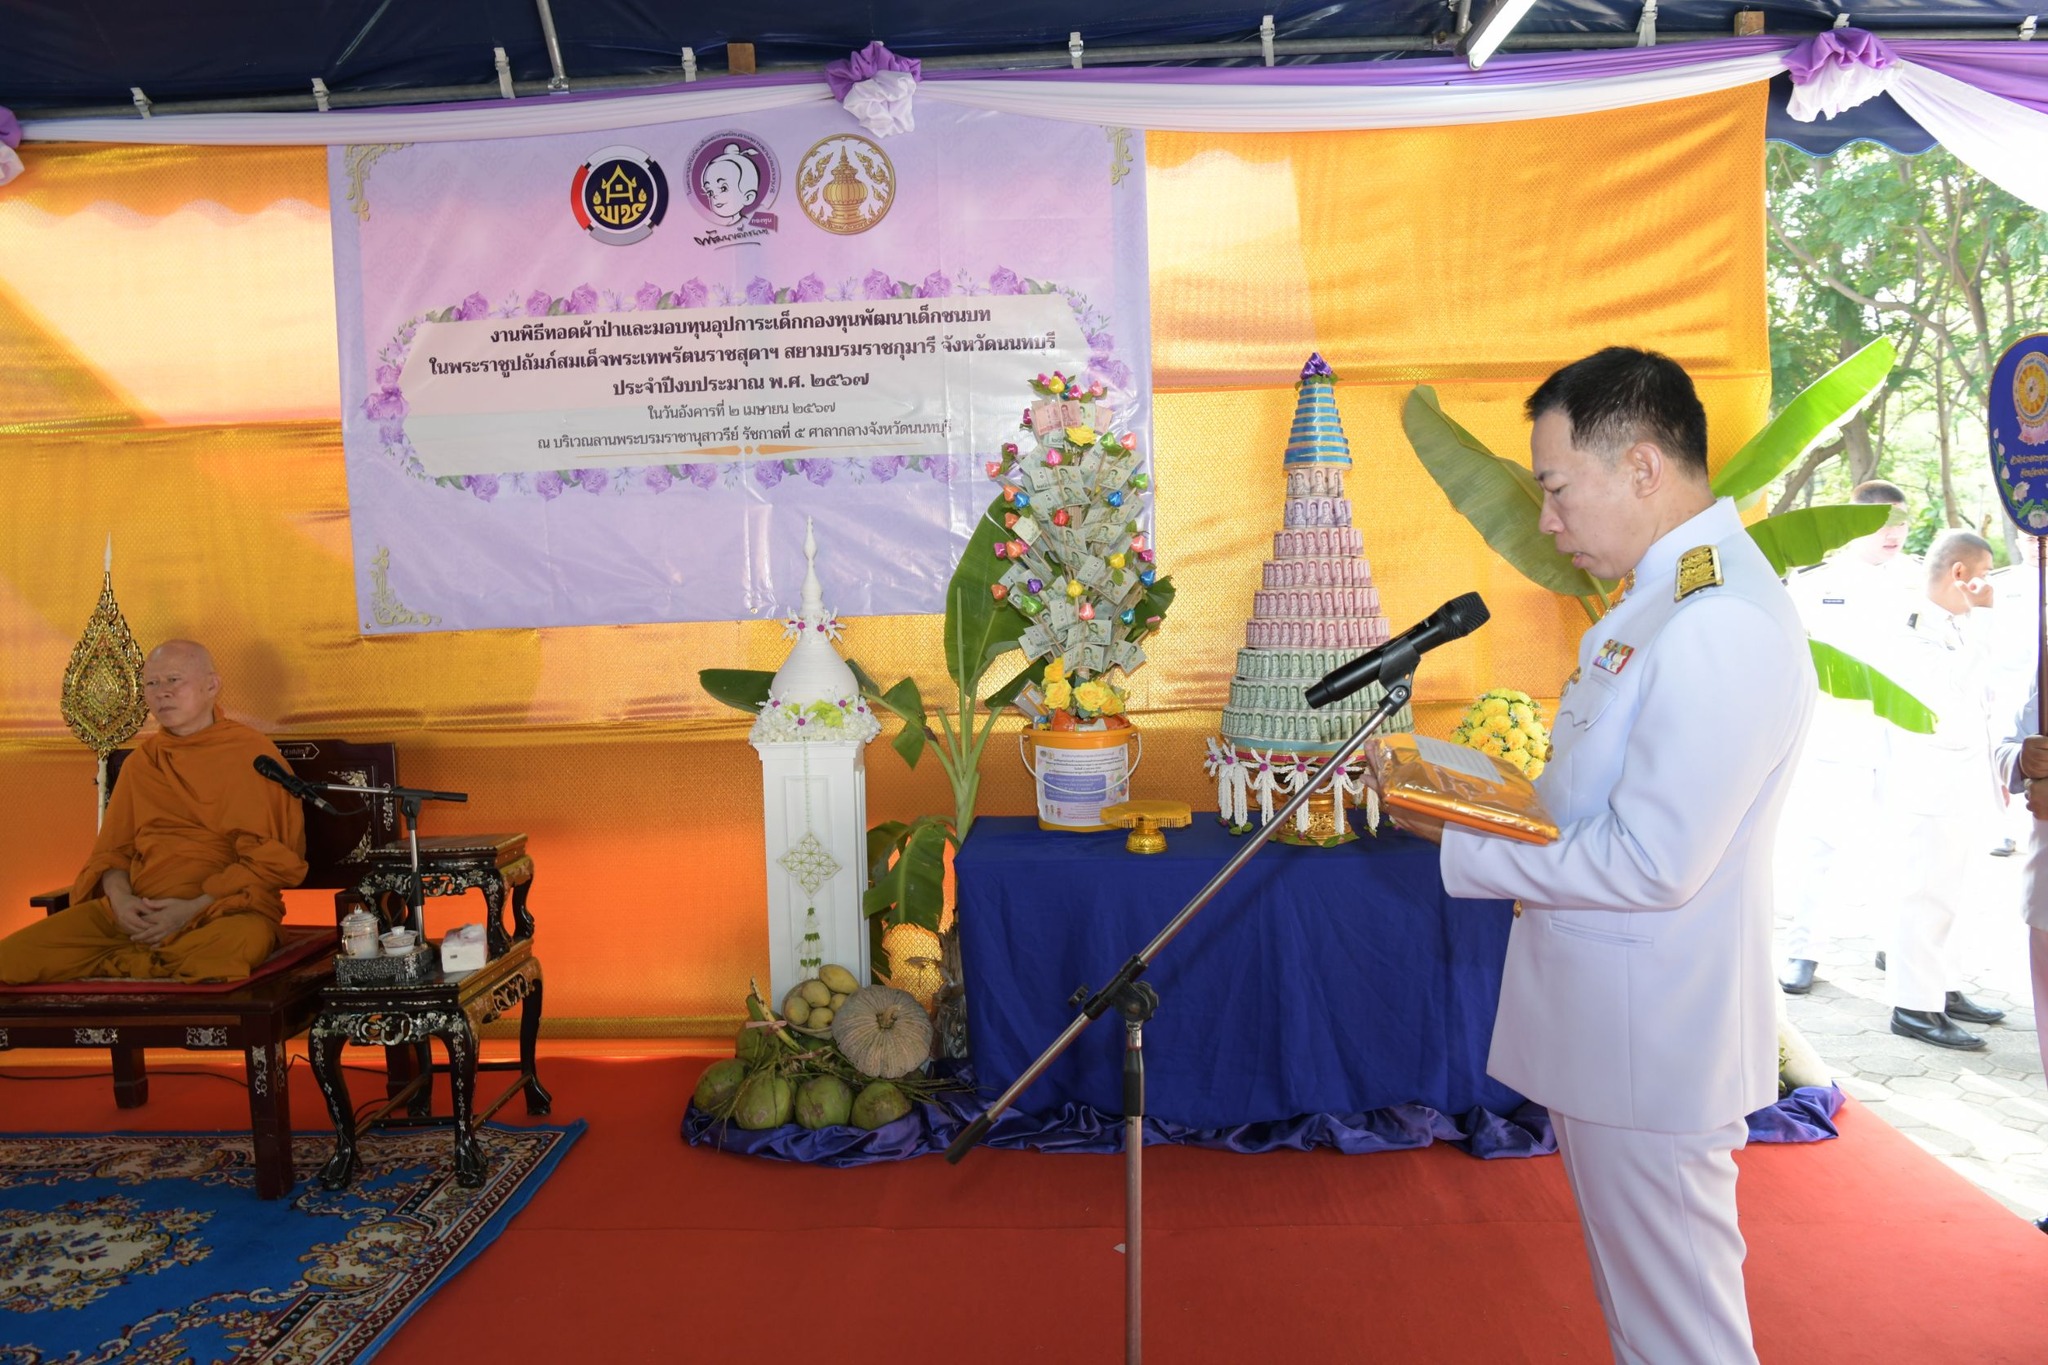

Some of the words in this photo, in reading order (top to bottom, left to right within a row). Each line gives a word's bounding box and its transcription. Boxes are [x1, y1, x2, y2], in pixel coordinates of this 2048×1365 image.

[490, 303, 991, 343] งานพิธีทอดผ้าป่าและมอบทุนอุปการะเด็กกองทุนพัฒนาเด็กชนบท
[429, 345, 779, 378] ในพระราชูปถัมภ์สมเด็จพระเทพรัตนราชสุดาฯ
[784, 335, 936, 361] สยามบรมราชกุมารี
[941, 331, 1056, 356] จังหวัดนนทบุรี
[613, 375, 764, 396] ประจำปีงบประมาณ
[769, 374, 805, 389] พ.ศ.
[810, 372, 870, 387] ๒๕๖๗
[647, 400, 725, 420] ในวันอังคารที่
[728, 405, 740, 417] ๒
[743, 403, 789, 416] เมษายน
[792, 401, 836, 414] ๒๕๖๗
[537, 438, 551, 450] ณ
[553, 425, 739, 450] บริเวณลานพระบรมราชานุสาวรีย์
[742, 422, 791, 440] รัชกาลที่
[794, 427, 806, 438] ๕
